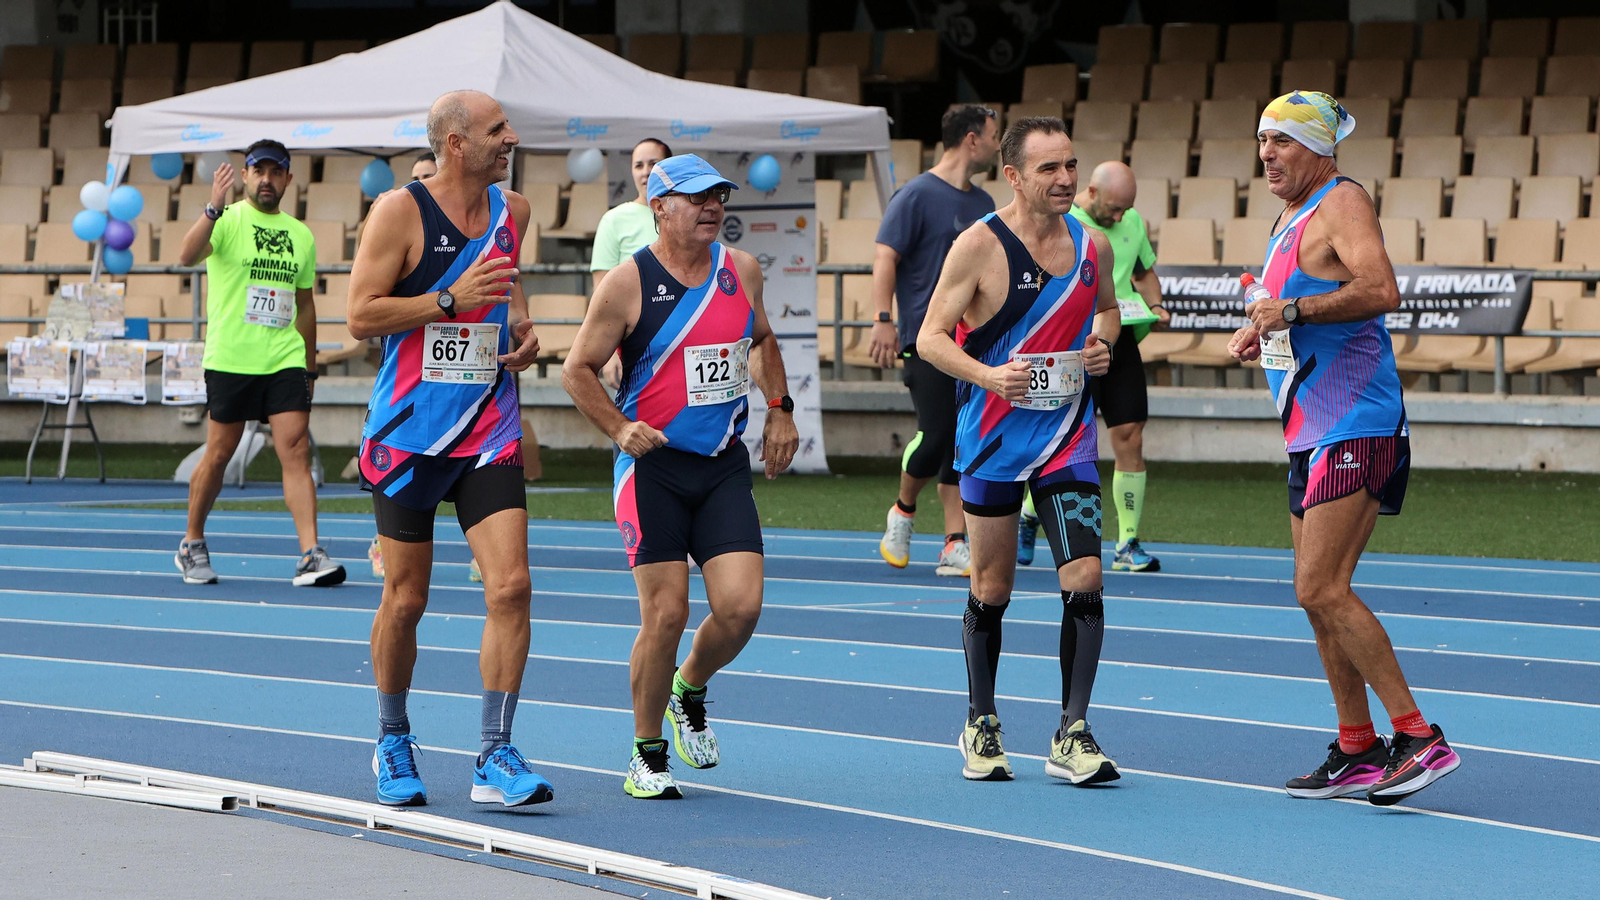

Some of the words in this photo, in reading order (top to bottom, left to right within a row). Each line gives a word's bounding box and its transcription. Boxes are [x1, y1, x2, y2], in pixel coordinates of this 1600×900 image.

[251, 257, 299, 273] ANIMALS
[250, 269, 295, 284] RUNNING
[1158, 272, 1241, 296] IVISIÓN
[1413, 273, 1517, 294] PRIVADA
[252, 295, 275, 312] 770
[651, 294, 675, 302] VIATOR
[1161, 300, 1208, 310] PRESA
[1210, 300, 1244, 310] AUTO
[1399, 298, 1460, 309] NTERIOR
[1417, 311, 1460, 329] 044
[432, 339, 470, 361] 667
[695, 360, 730, 384] 122
[1029, 369, 1049, 390] 89
